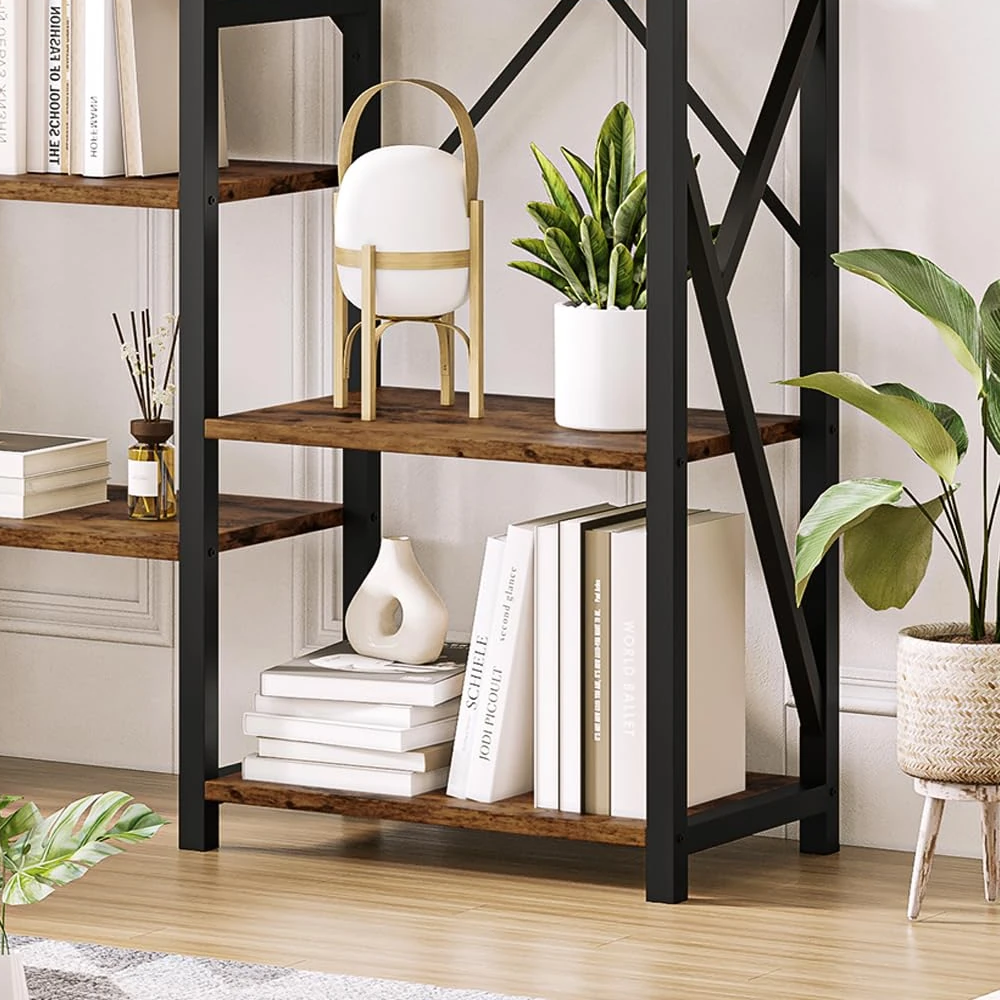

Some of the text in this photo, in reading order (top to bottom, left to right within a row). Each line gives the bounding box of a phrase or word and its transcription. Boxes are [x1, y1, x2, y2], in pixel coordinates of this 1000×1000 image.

[466, 635, 489, 710] SCHIELE
[479, 566, 518, 761] JODI PICOULT second glance
[623, 621, 635, 737] WORLD BALLET
